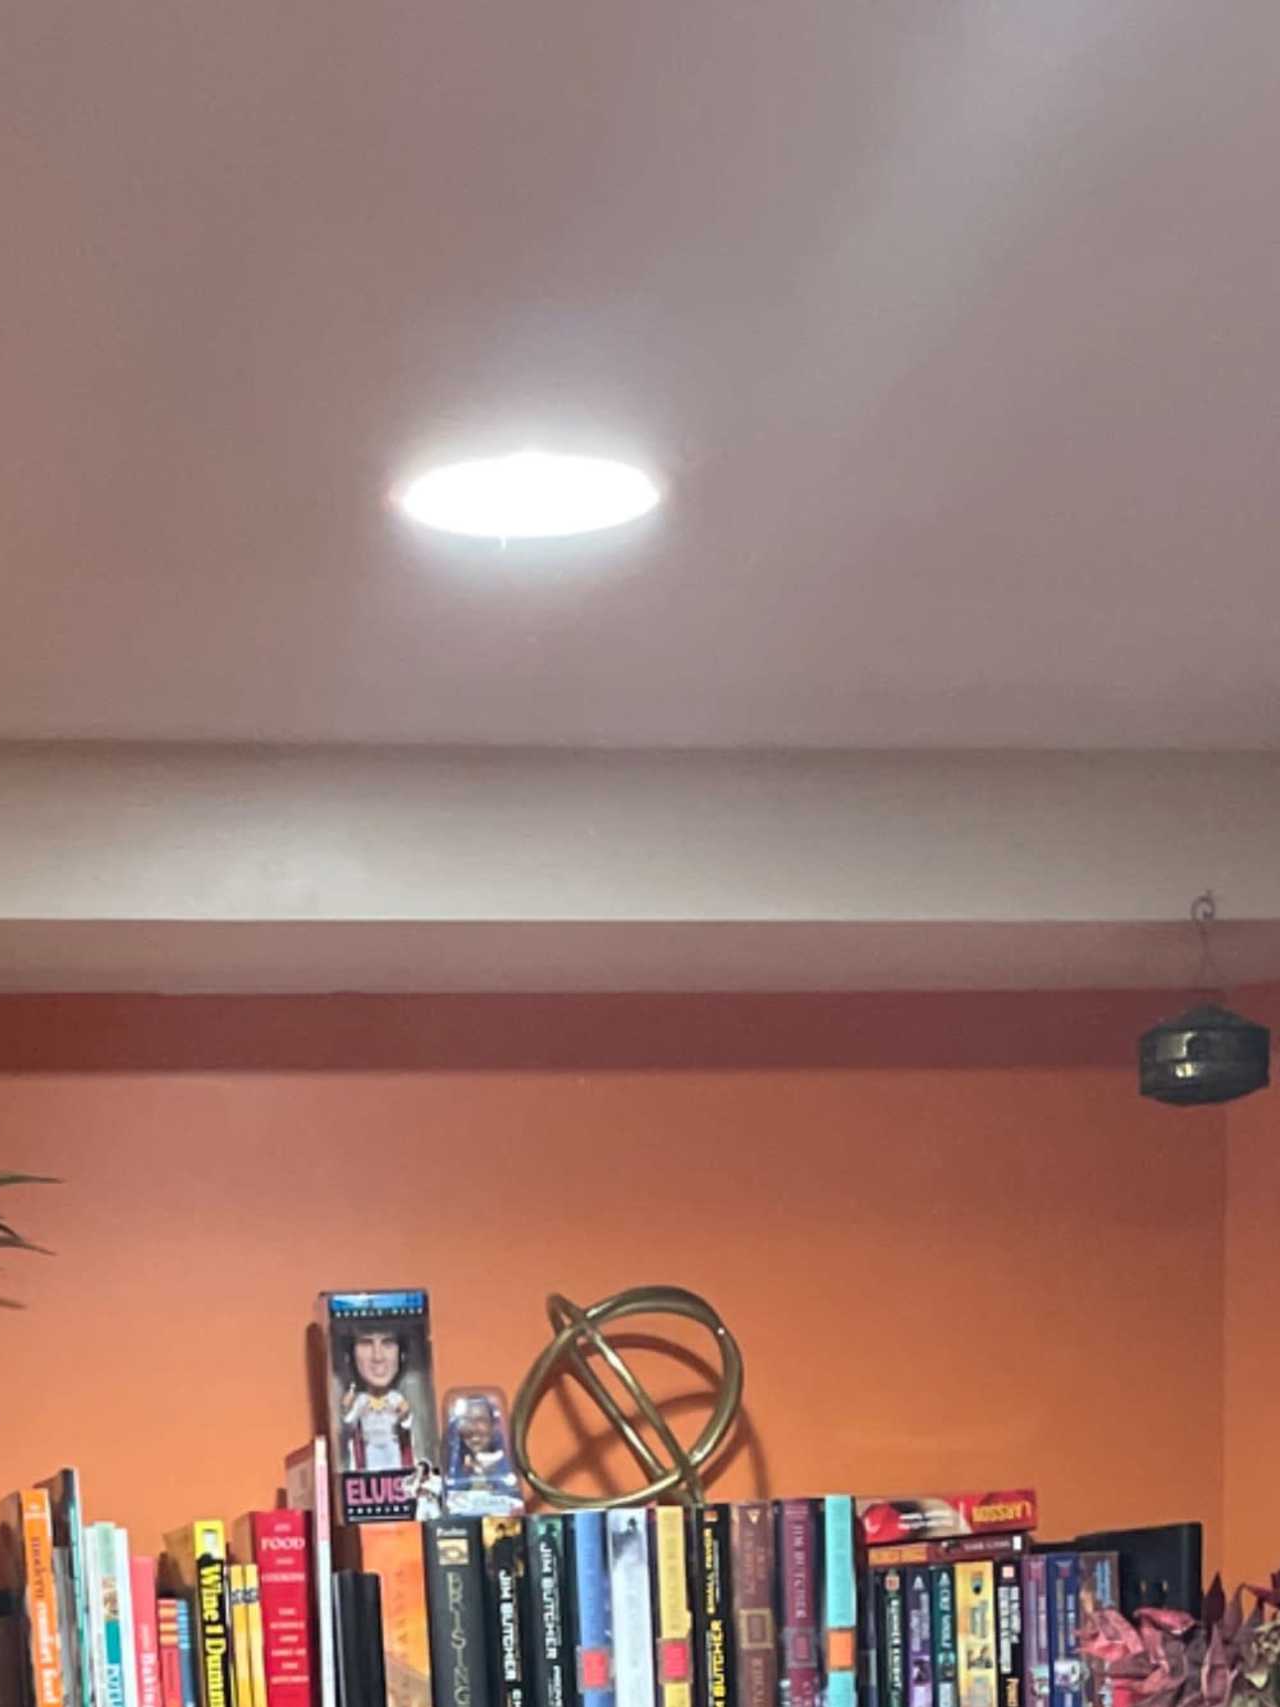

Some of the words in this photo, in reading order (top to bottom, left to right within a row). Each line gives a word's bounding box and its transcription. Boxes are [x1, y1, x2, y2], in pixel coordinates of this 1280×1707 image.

[345, 1477, 409, 1505] ELVIS
[261, 1537, 306, 1550] FOOD
[536, 1540, 553, 1573] JIM
[790, 1523, 804, 1548] JIM
[196, 1562, 228, 1621] Wine
[496, 1568, 513, 1600] JIM
[790, 1549, 809, 1619] BUTCHER
[538, 1574, 562, 1659] BUTCHER
[496, 1601, 521, 1681] BUTCHER
[705, 1618, 728, 1698] BUTCHER
